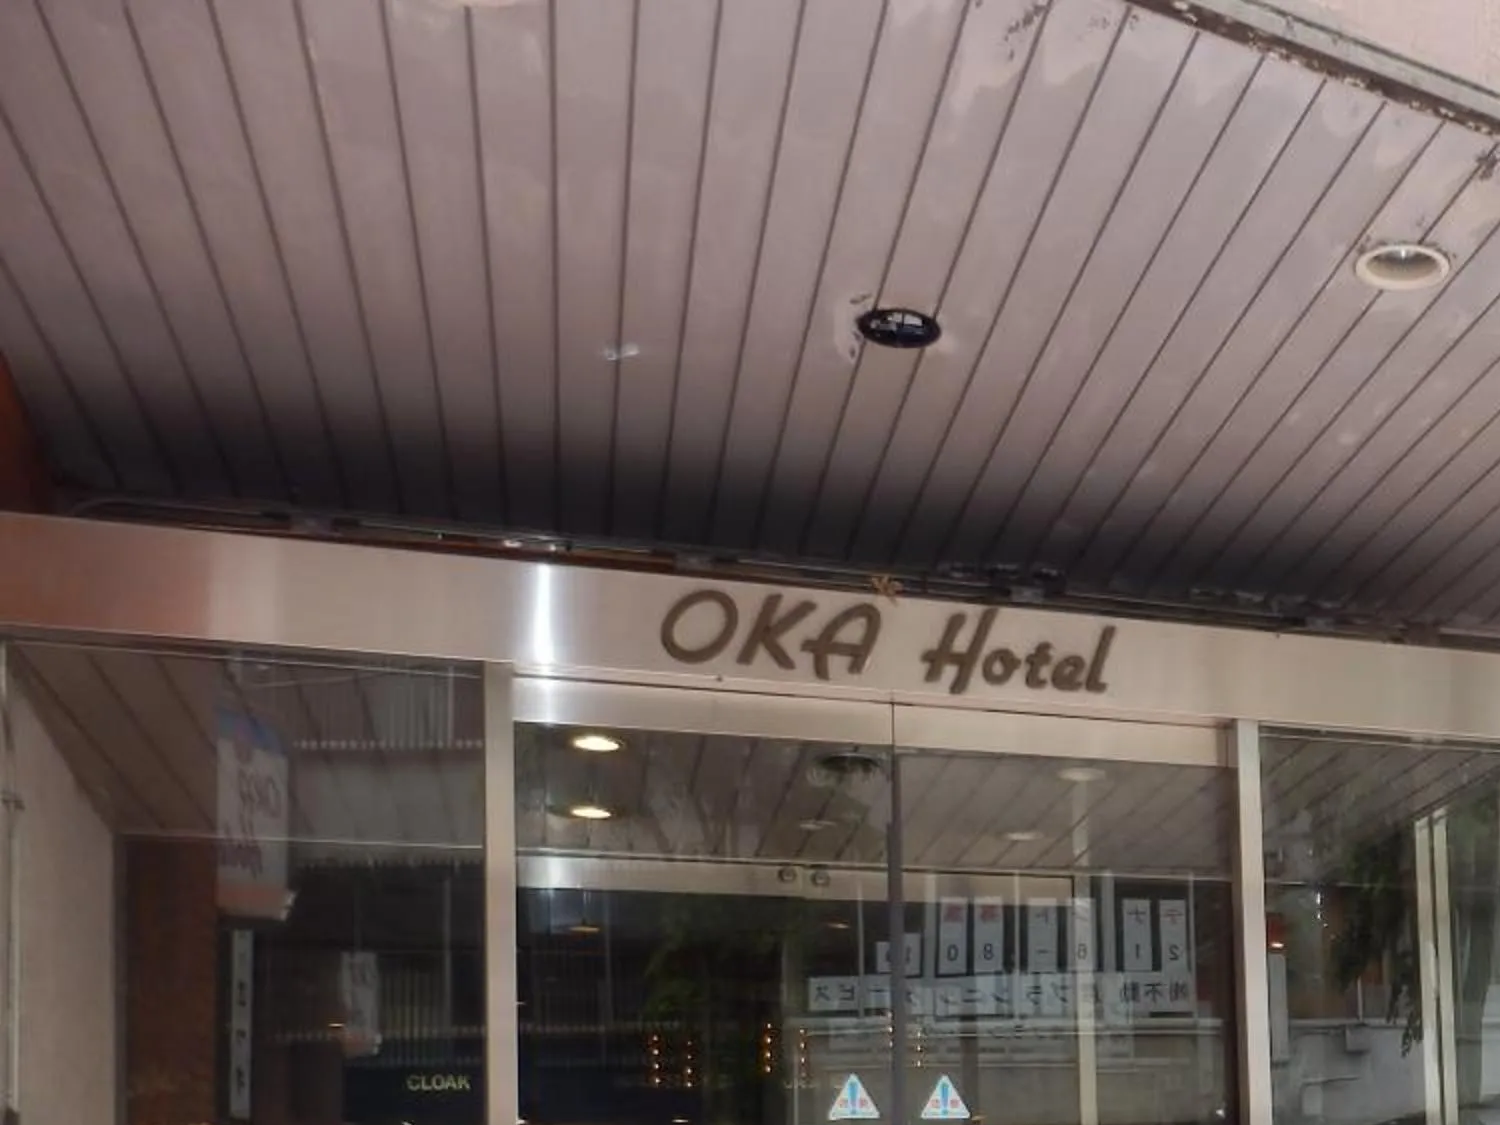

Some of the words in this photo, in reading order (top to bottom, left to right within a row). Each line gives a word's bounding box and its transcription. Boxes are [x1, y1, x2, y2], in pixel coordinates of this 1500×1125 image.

[660, 589, 882, 681] OKA
[920, 607, 1117, 694] Hotel
[406, 1073, 471, 1092] CLOAK
